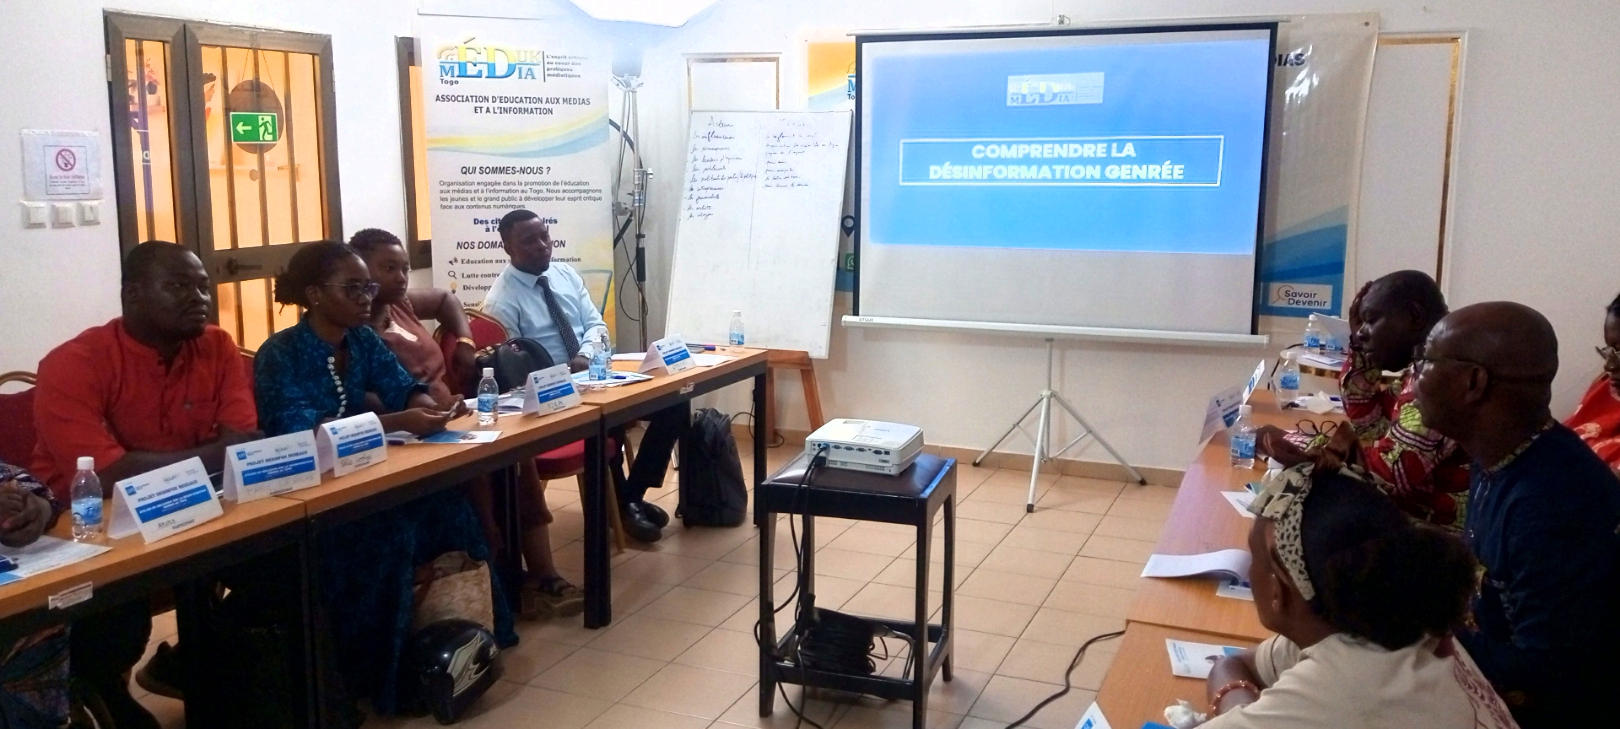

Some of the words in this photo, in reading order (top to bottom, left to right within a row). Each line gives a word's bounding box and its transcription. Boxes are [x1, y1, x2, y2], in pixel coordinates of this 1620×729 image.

[435, 94, 490, 104] ASSOCIATION
[491, 95, 543, 105] D'EDUCATION
[544, 97, 561, 105] AUX
[562, 97, 591, 106] MEDIAS
[474, 106, 484, 114] ET
[493, 106, 553, 116] L'INFORMATION
[971, 144, 1108, 159] COMPRENDRE
[1111, 142, 1137, 158] LA
[460, 166, 477, 176] QUI
[478, 166, 544, 175] SOMMES-NOUS
[929, 161, 1101, 180] DÉSINFORMATION
[1104, 160, 1185, 180] GENRÉE
[476, 180, 502, 188] engagée
[523, 195, 555, 203] développer
[456, 241, 476, 250] NOS
[477, 240, 504, 249] DOMA
[1284, 289, 1317, 299] Savoir
[1288, 298, 1327, 307] Devenir
